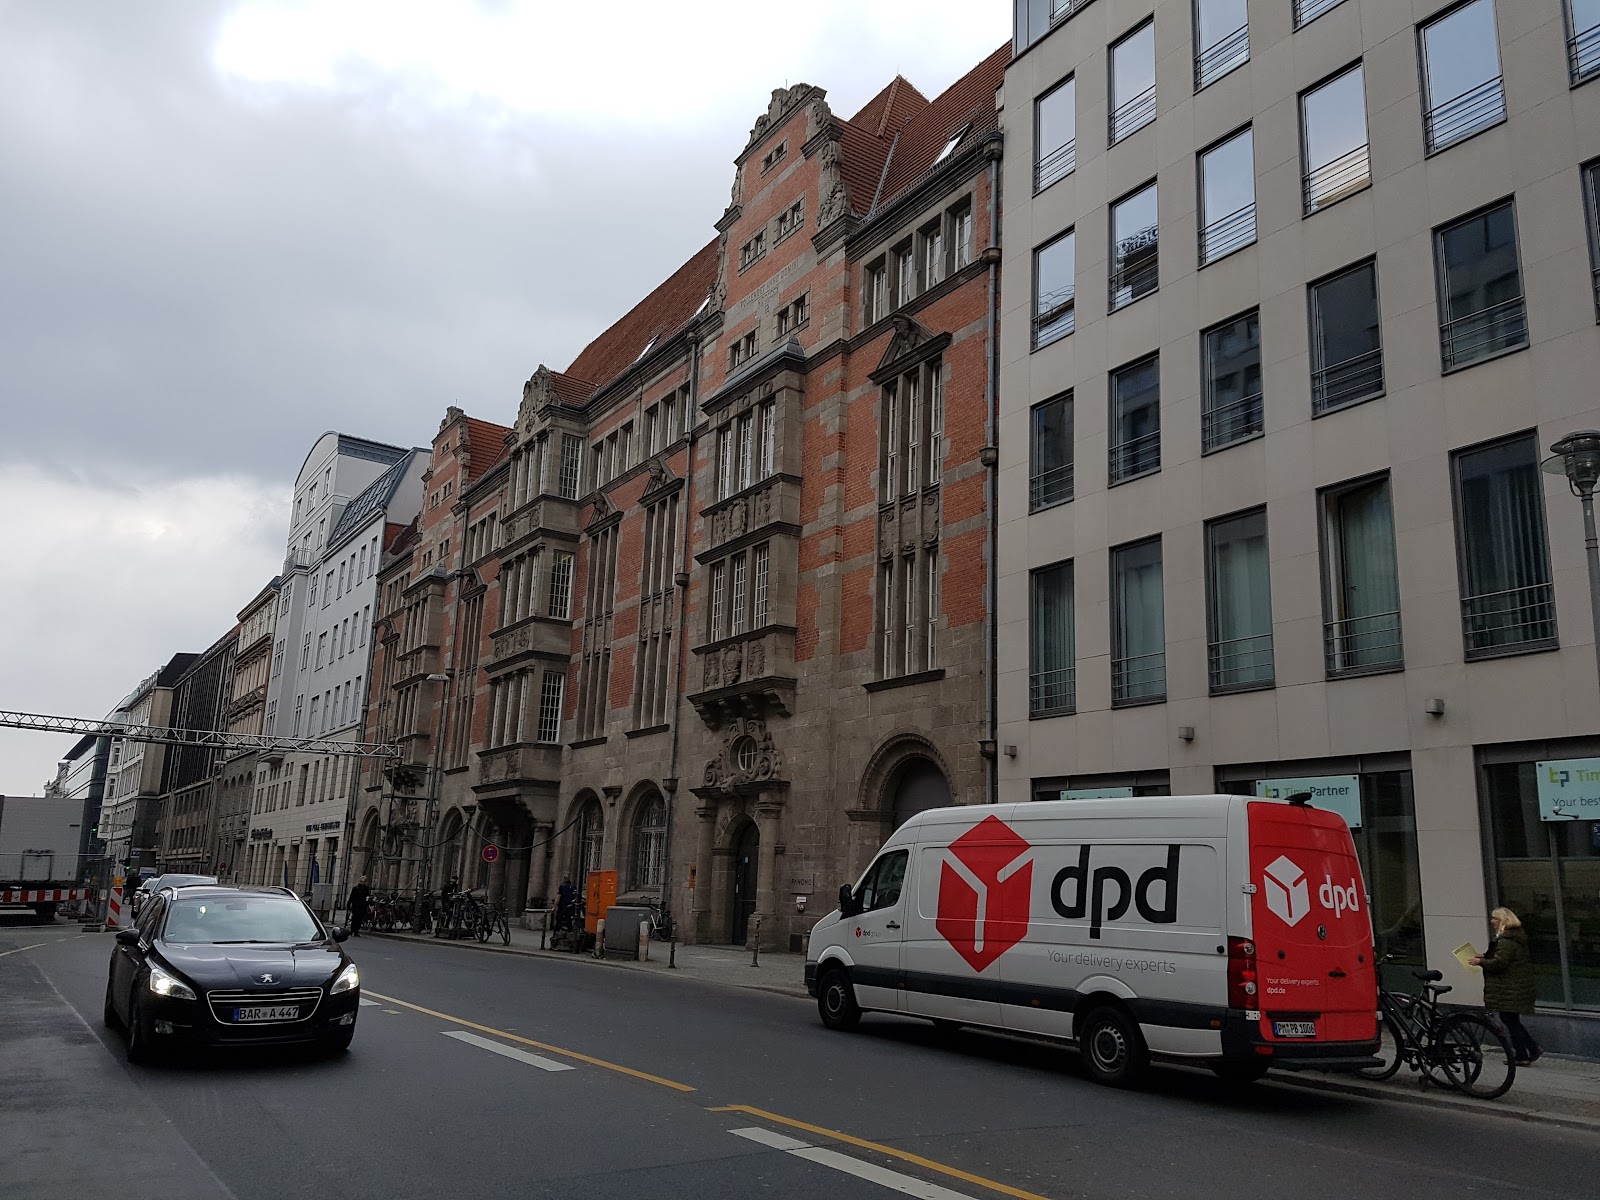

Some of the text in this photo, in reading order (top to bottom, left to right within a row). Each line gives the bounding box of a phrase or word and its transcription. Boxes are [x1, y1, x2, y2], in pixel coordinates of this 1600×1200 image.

[1552, 797, 1600, 807] Your bes
[1051, 845, 1180, 939] dpd
[1319, 874, 1359, 918] dpd
[1047, 949, 1176, 974] Your delivery experts
[1280, 978, 1300, 986] delivery
[1266, 987, 1286, 995] dpd.de
[240, 1007, 298, 1019] BAR A 447
